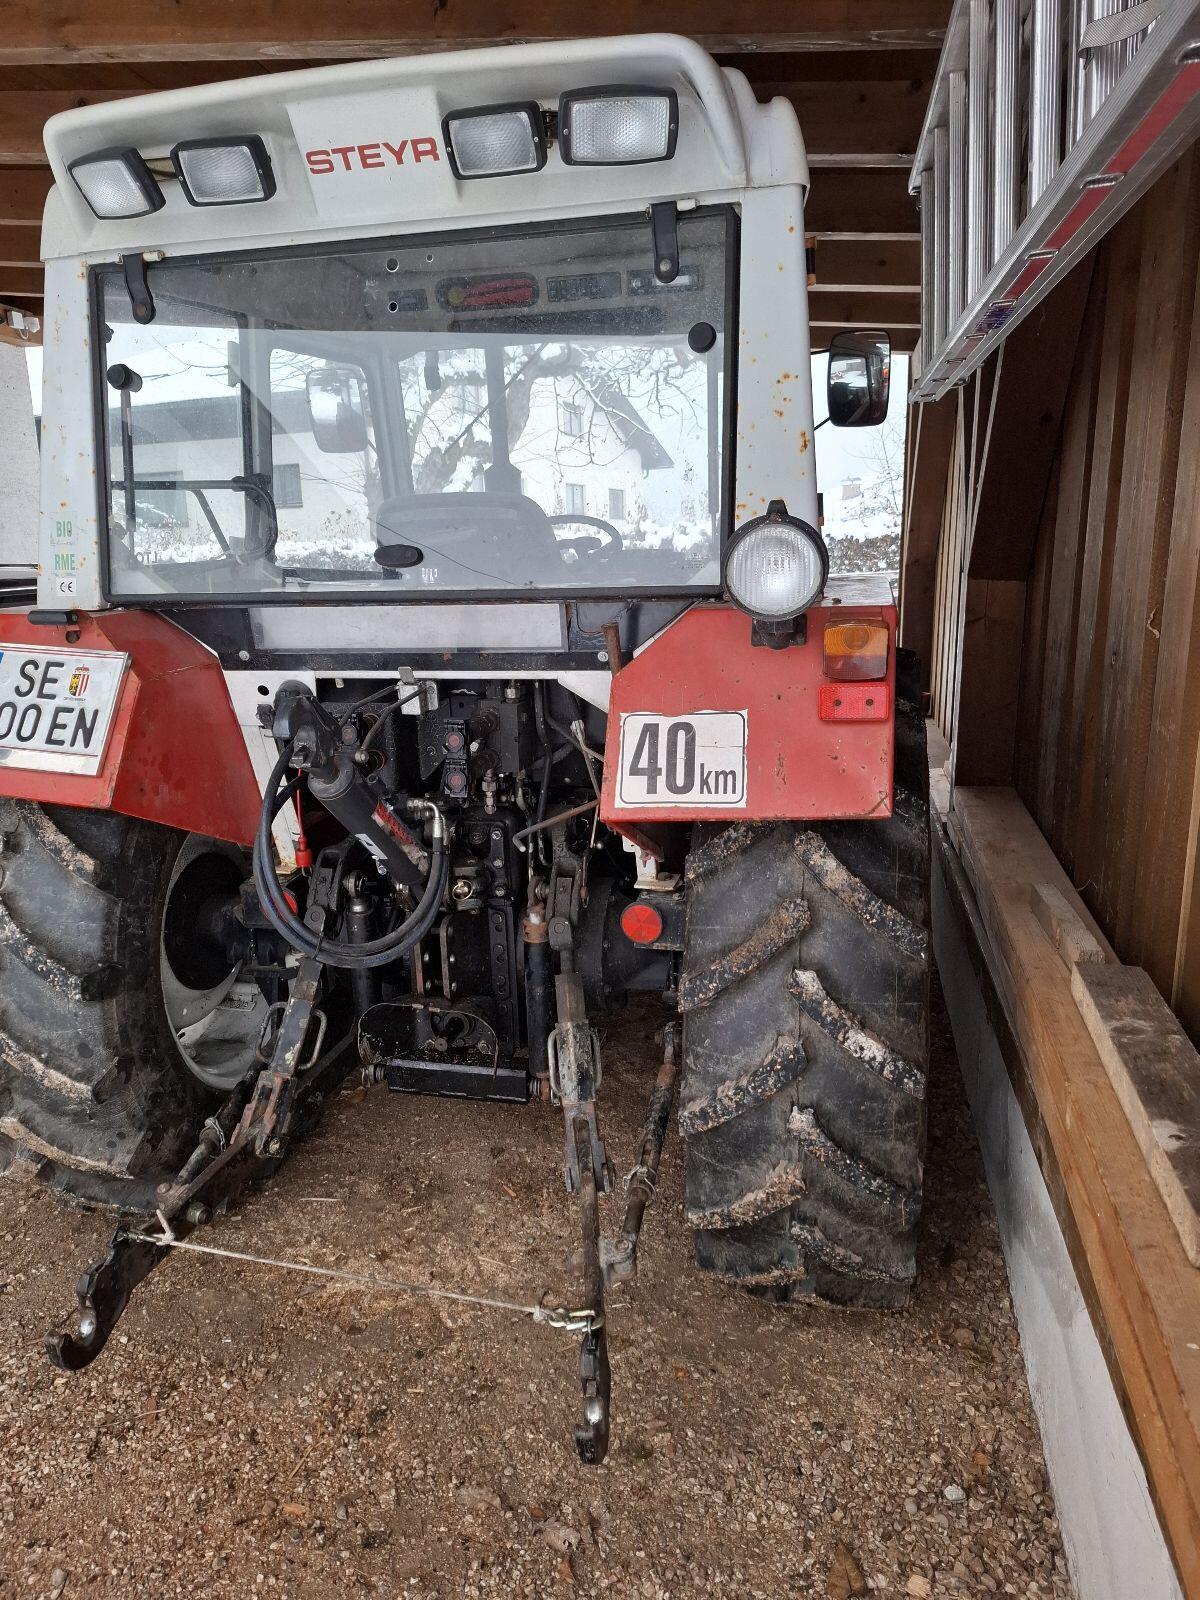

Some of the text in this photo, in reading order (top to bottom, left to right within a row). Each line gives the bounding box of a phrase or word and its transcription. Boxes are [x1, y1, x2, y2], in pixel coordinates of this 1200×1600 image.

[305, 137, 440, 174] STEYR
[56, 520, 73, 537] BIO
[54, 554, 76, 571] RME
[14, 659, 64, 700] SE
